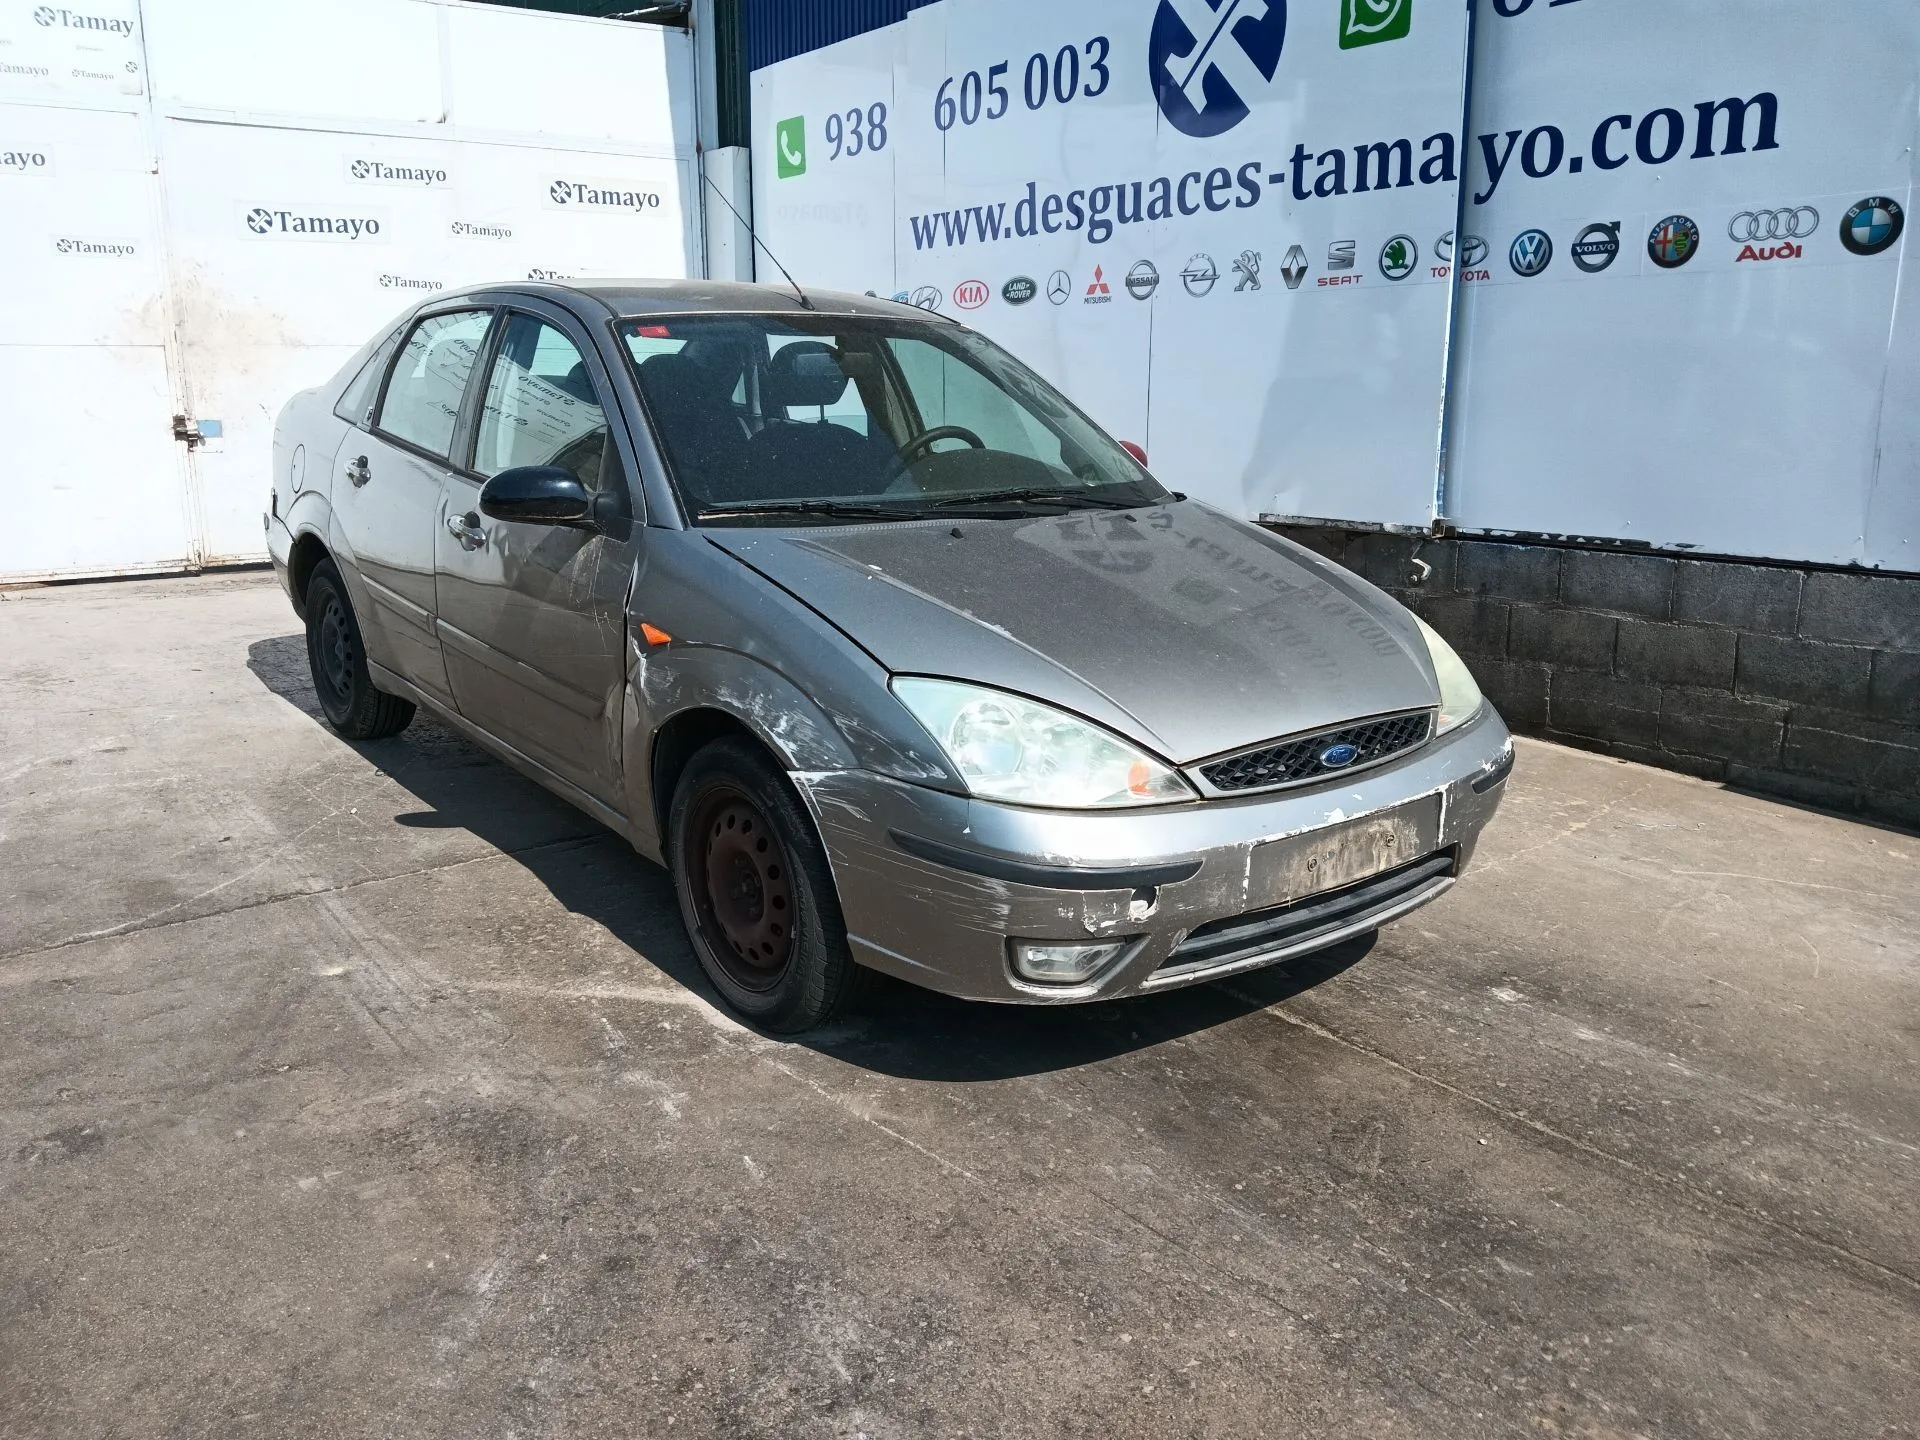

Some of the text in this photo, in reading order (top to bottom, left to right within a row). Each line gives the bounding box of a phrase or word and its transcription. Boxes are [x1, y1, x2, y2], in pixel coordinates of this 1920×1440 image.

[824, 36, 1111, 161] 938 605 003
[0, 152, 46, 171] ayo
[371, 162, 447, 185] Tamayo
[909, 91, 1779, 251] www.desguaces-tamayo.com
[573, 184, 660, 212] Tamayo
[274, 211, 380, 240] Tamayo
[463, 223, 512, 239] Tamayo
[1649, 217, 1698, 244] ALFA ROMEO
[73, 240, 135, 256] Tamayo
[1575, 243, 1616, 253] VOLVO
[1735, 242, 1803, 263] Audi
[392, 276, 443, 292] Tamayo
[1008, 282, 1026, 291] LAND
[1128, 276, 1157, 286] NISSAN
[1317, 275, 1363, 287] SEAT
[959, 289, 983, 304] KIA
[1009, 290, 1031, 299] ROVER
